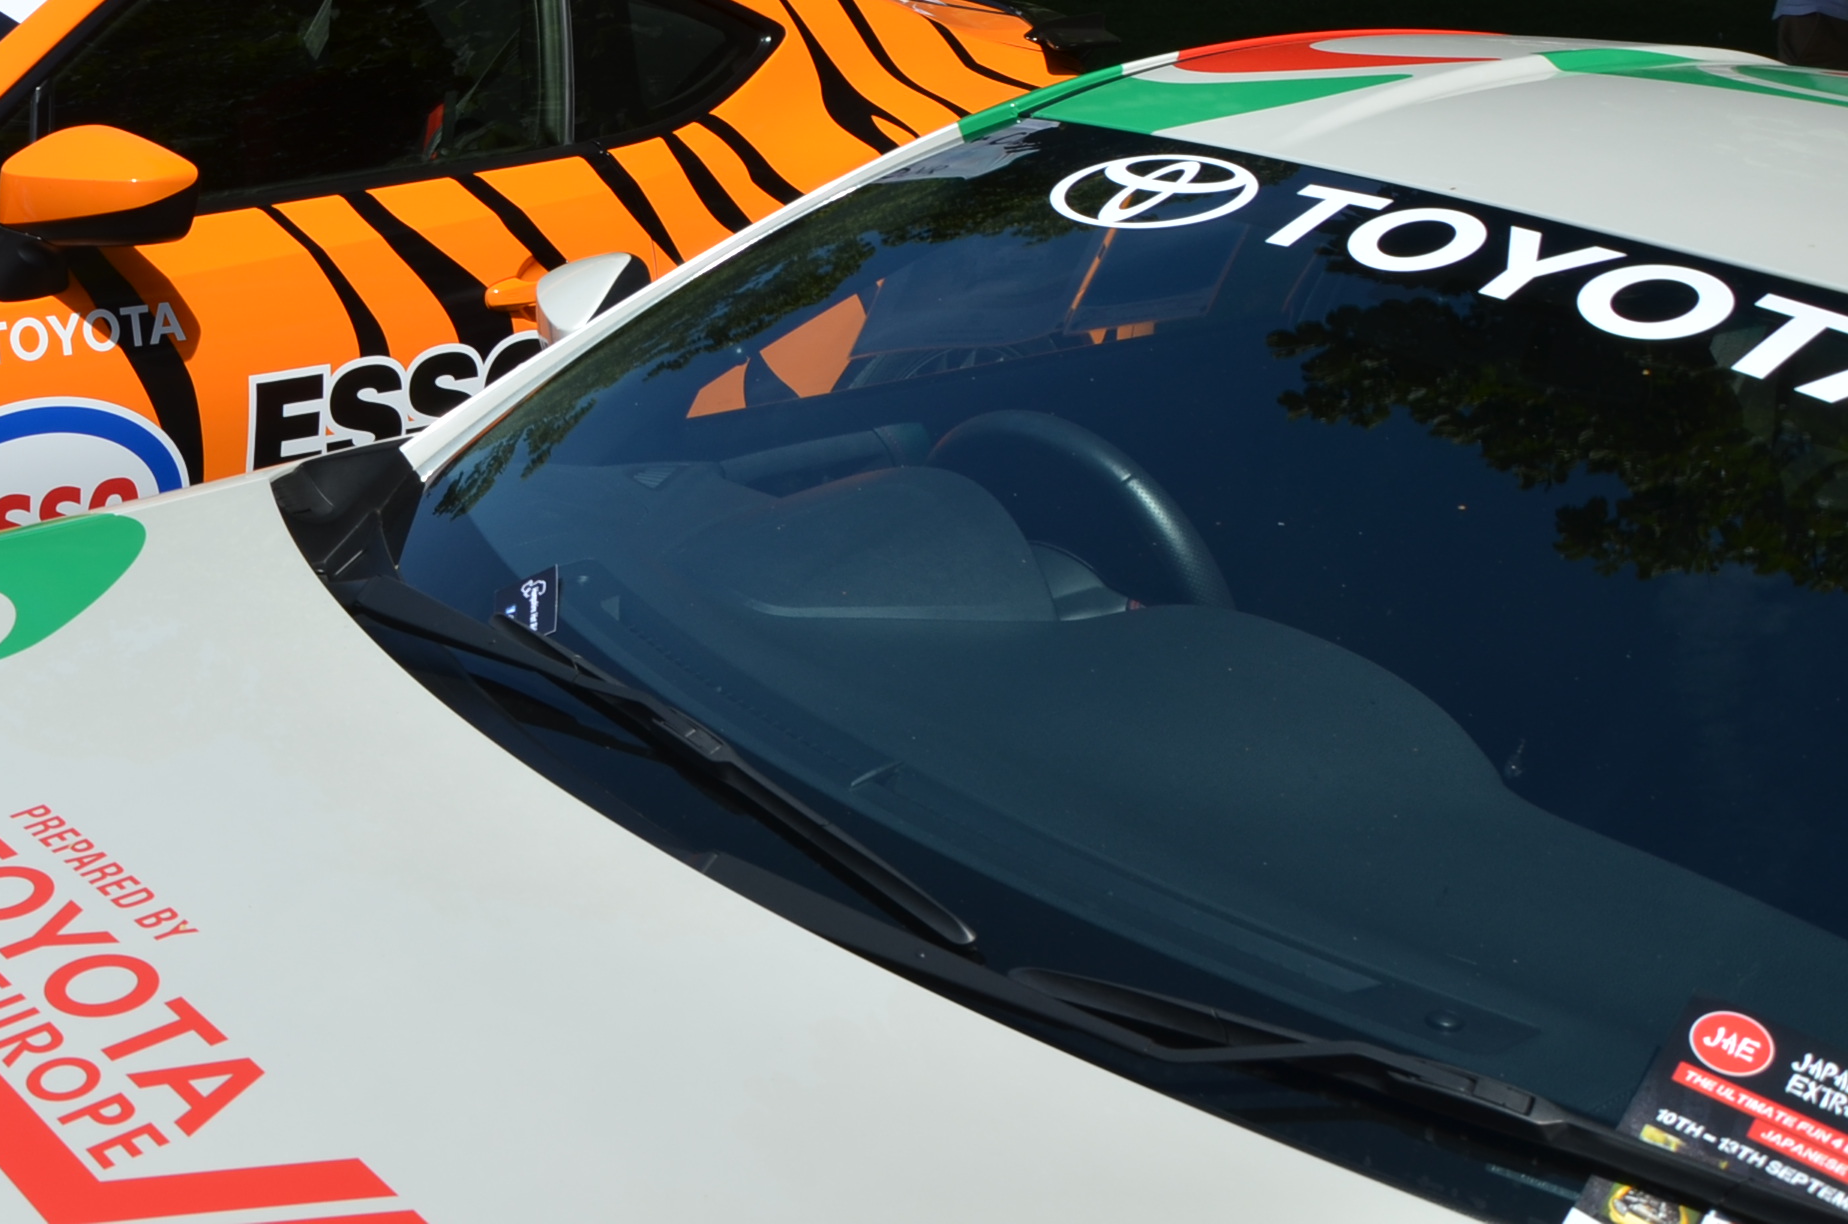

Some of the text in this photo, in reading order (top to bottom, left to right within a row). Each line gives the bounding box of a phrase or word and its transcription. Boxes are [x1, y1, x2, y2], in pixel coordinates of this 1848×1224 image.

[9, 803, 200, 941] PREPARED BY
[1703, 1026, 1761, 1063] JAE
[1685, 1069, 1717, 1093] THE
[1716, 1084, 1798, 1128] ULTIMATE
[1795, 1121, 1833, 1144] FUN
[1655, 1108, 1705, 1139] 10TH
[1717, 1136, 1769, 1169] 13TH
[1760, 1129, 1848, 1177] JAPANESE
